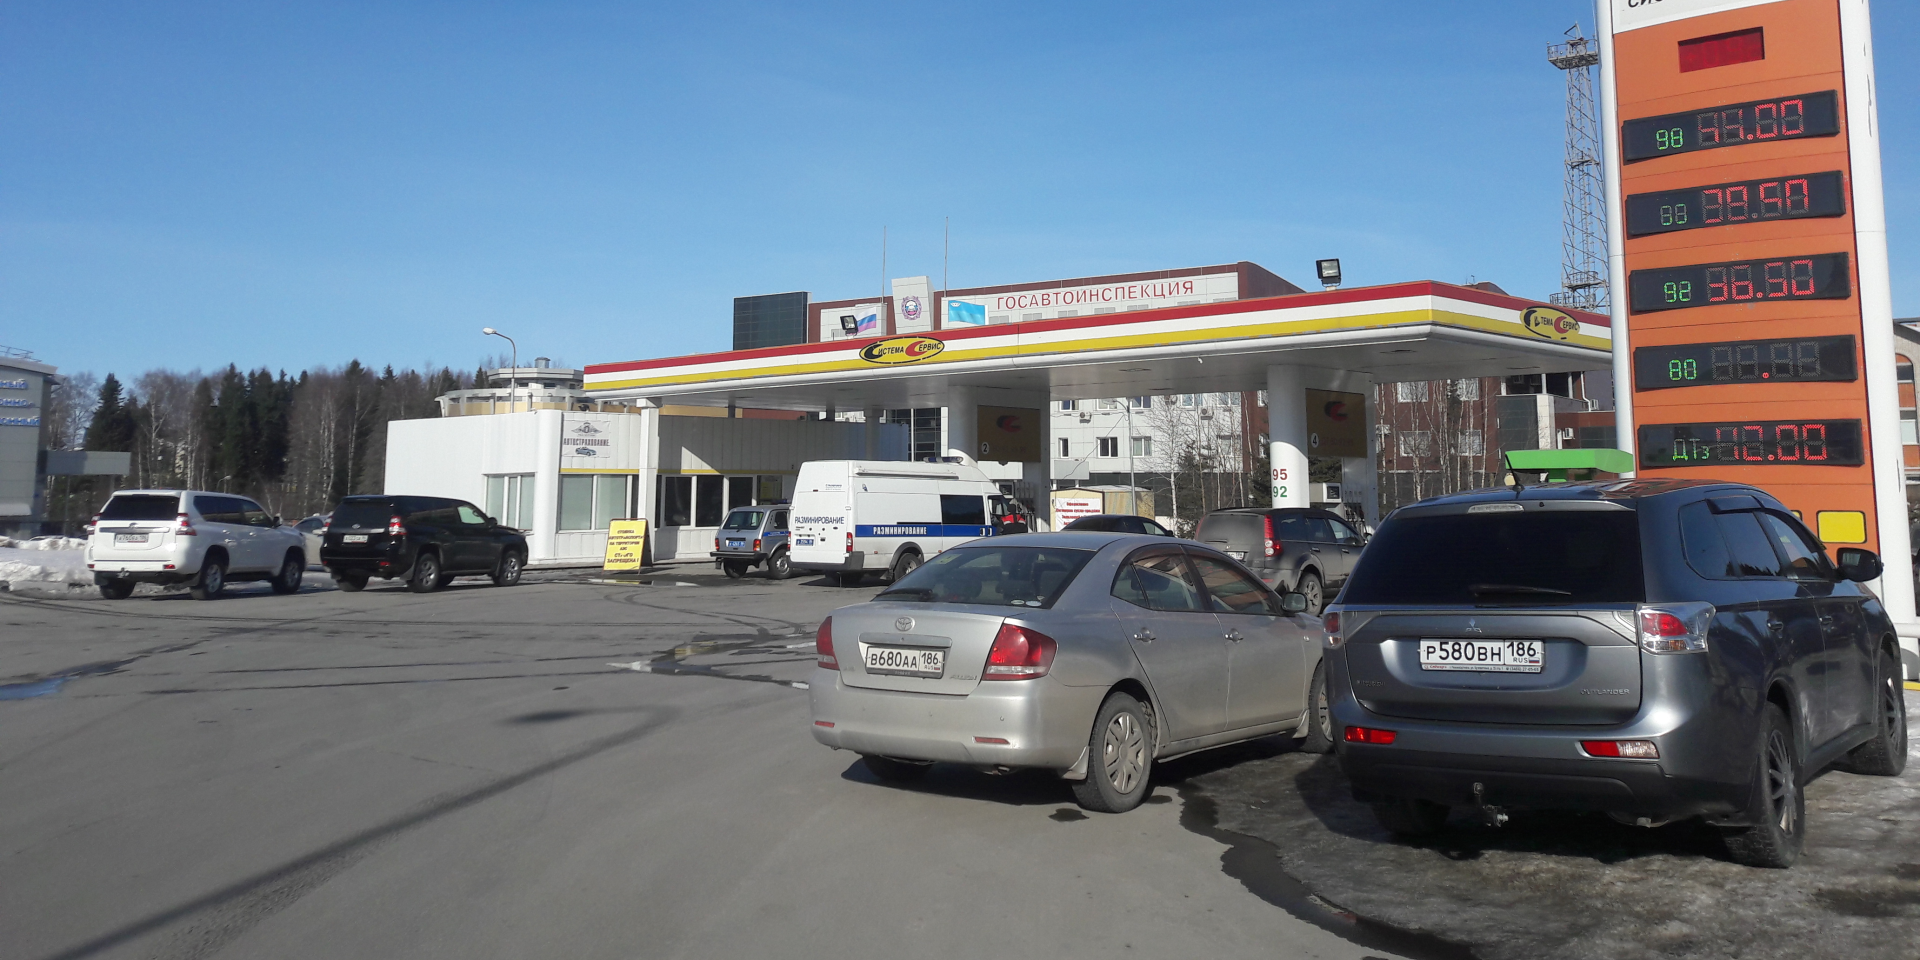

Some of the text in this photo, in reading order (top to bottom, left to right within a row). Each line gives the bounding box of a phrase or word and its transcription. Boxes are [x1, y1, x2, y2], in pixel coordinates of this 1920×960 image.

[1656, 127, 1683, 150] 98
[1663, 259, 1815, 303] 92 36.50
[997, 280, 1194, 310] ГОСАВТОИНСПЕКЦИЯ
[905, 340, 942, 357] СЕРВИС
[1668, 358, 1697, 381] 80
[983, 443, 988, 453] 2
[1312, 435, 1318, 446] 4
[1272, 468, 1288, 481] 95
[1272, 486, 1288, 498] 92
[795, 516, 845, 525] РАЗМИНИРОВАНИЕ
[873, 526, 927, 535] РАЗМИНИРОВАНИЕ
[870, 650, 918, 669] В680АА
[921, 652, 938, 665] 186
[1426, 641, 1537, 662] Р580ВН 186
